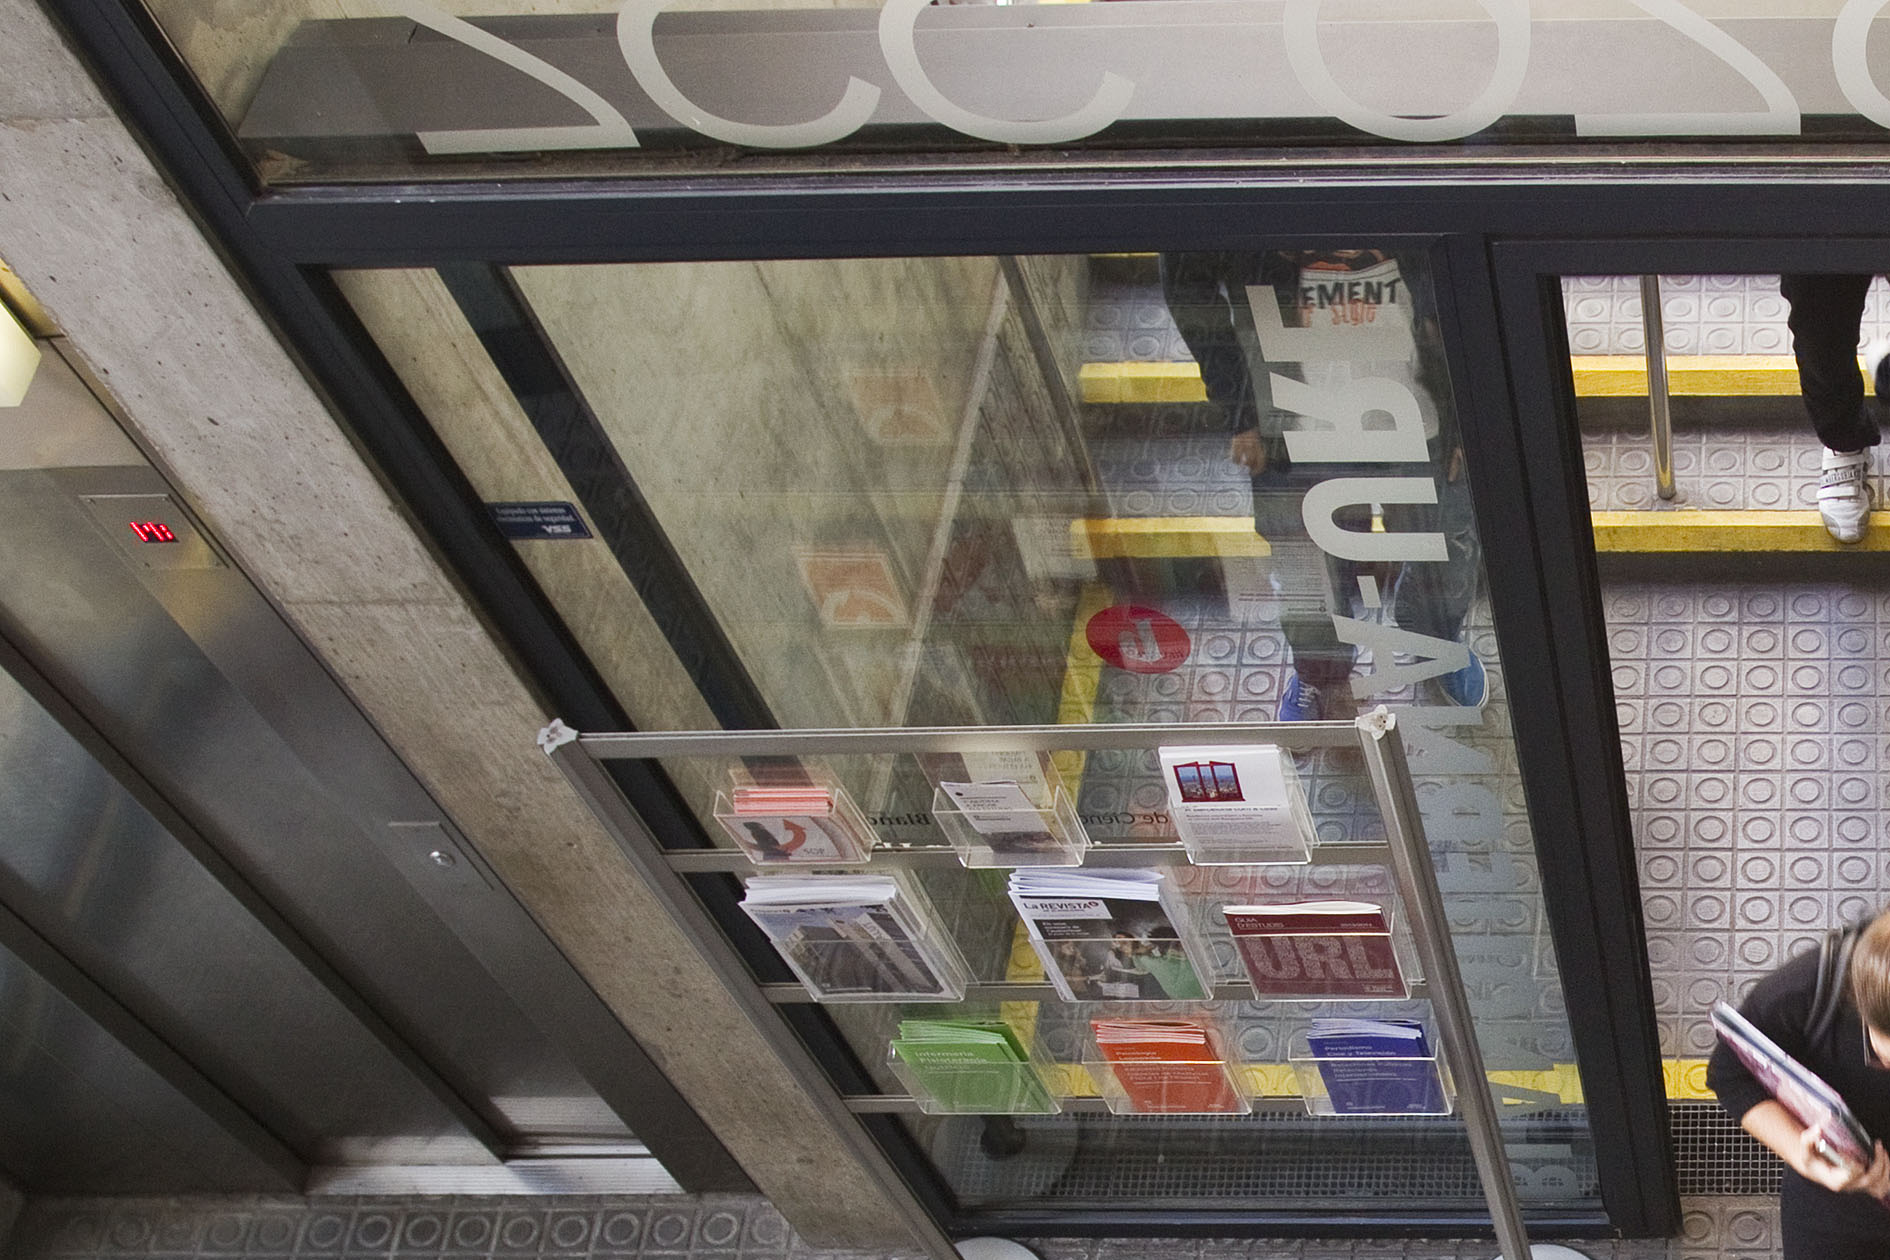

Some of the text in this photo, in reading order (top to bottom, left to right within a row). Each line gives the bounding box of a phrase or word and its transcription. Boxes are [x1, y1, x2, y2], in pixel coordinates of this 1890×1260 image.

[1023, 901, 1092, 910] La REVISTA
[1244, 936, 1396, 980] URL
